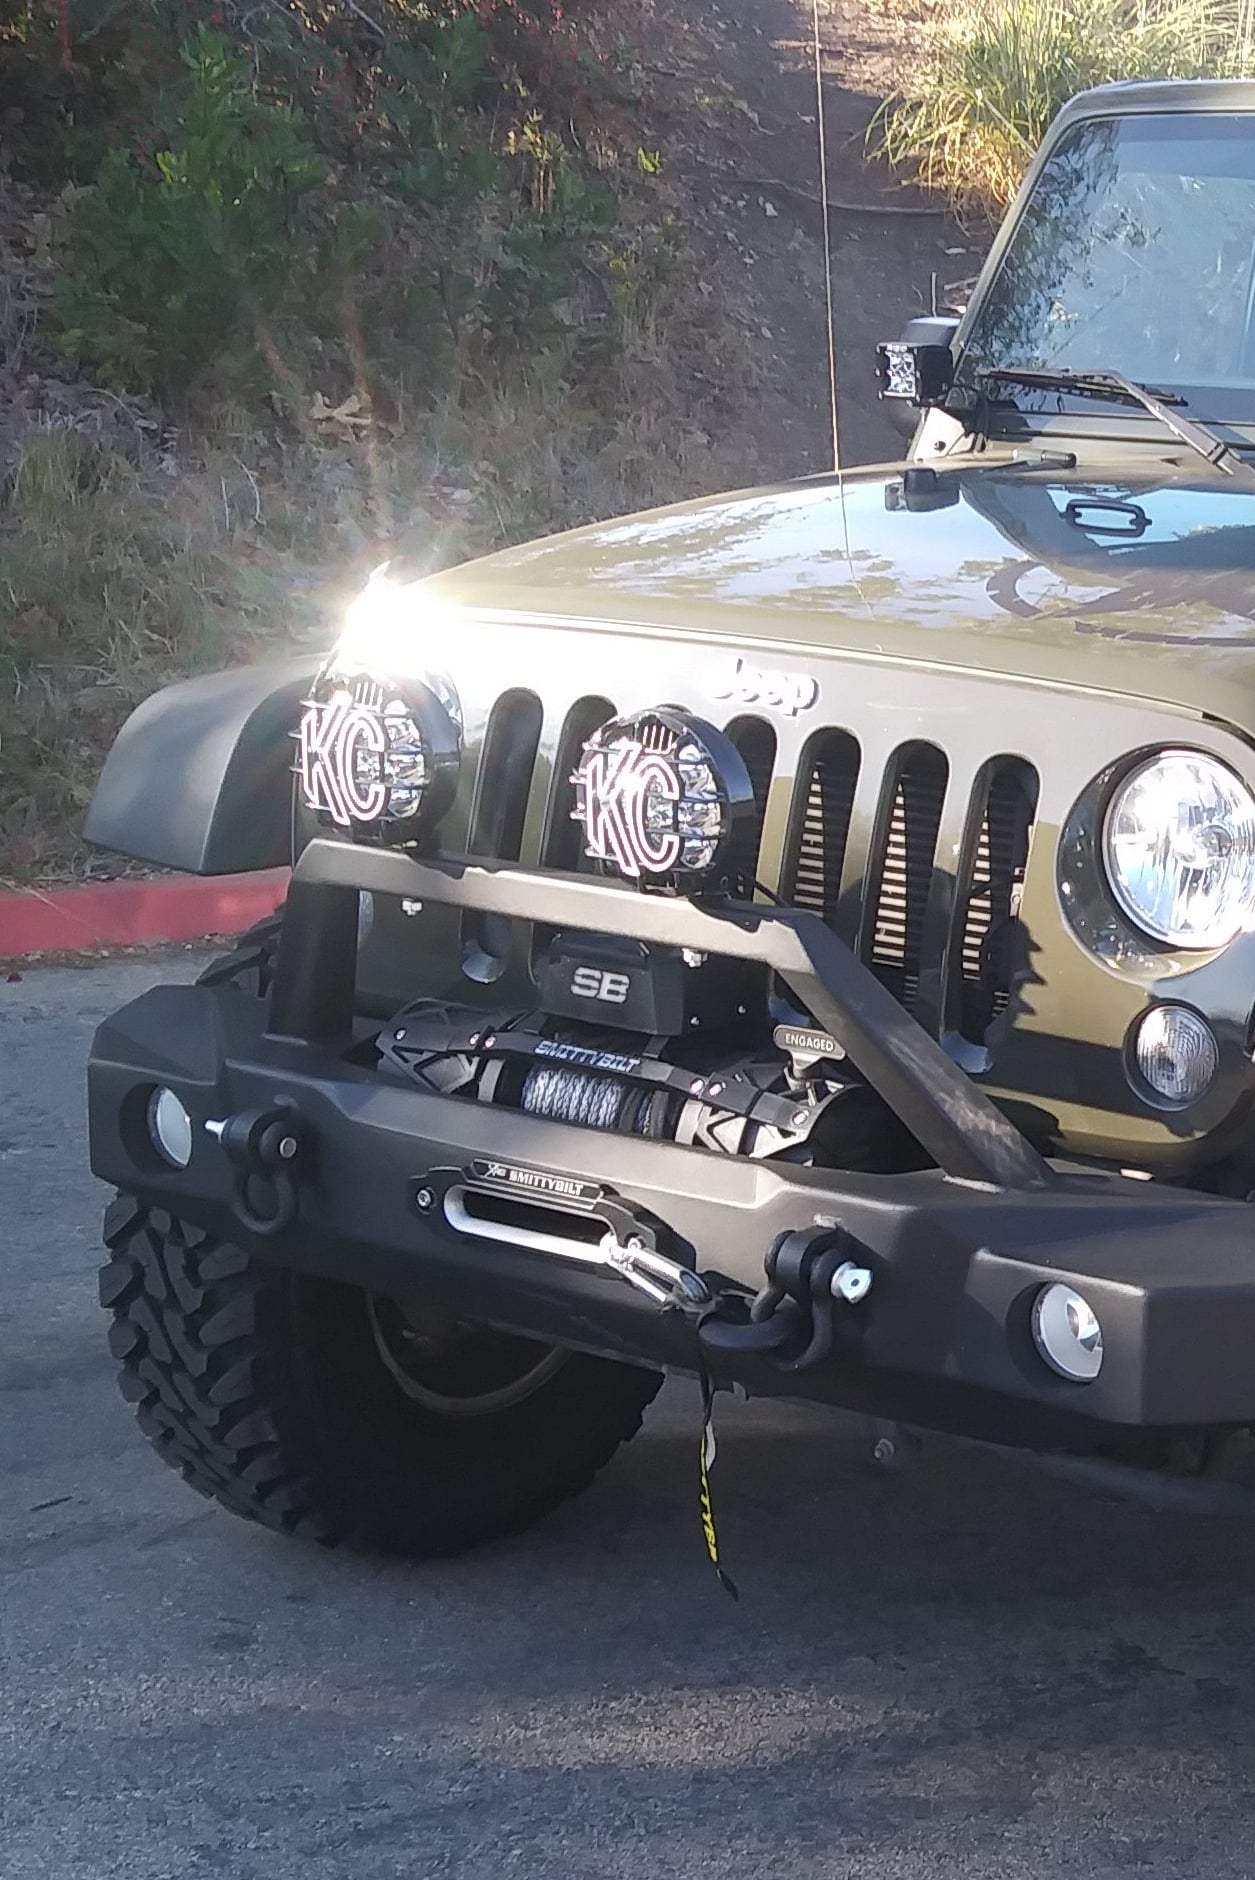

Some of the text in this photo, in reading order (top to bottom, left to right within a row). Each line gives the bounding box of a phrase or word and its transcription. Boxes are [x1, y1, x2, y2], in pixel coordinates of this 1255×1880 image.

[301, 698, 385, 826] KC
[586, 740, 680, 877] KC
[570, 966, 630, 1003] SB
[534, 1040, 641, 1073] SMITTYBILT
[785, 1033, 834, 1052] ENGAGED
[509, 1170, 584, 1196] SMITTYBILT
